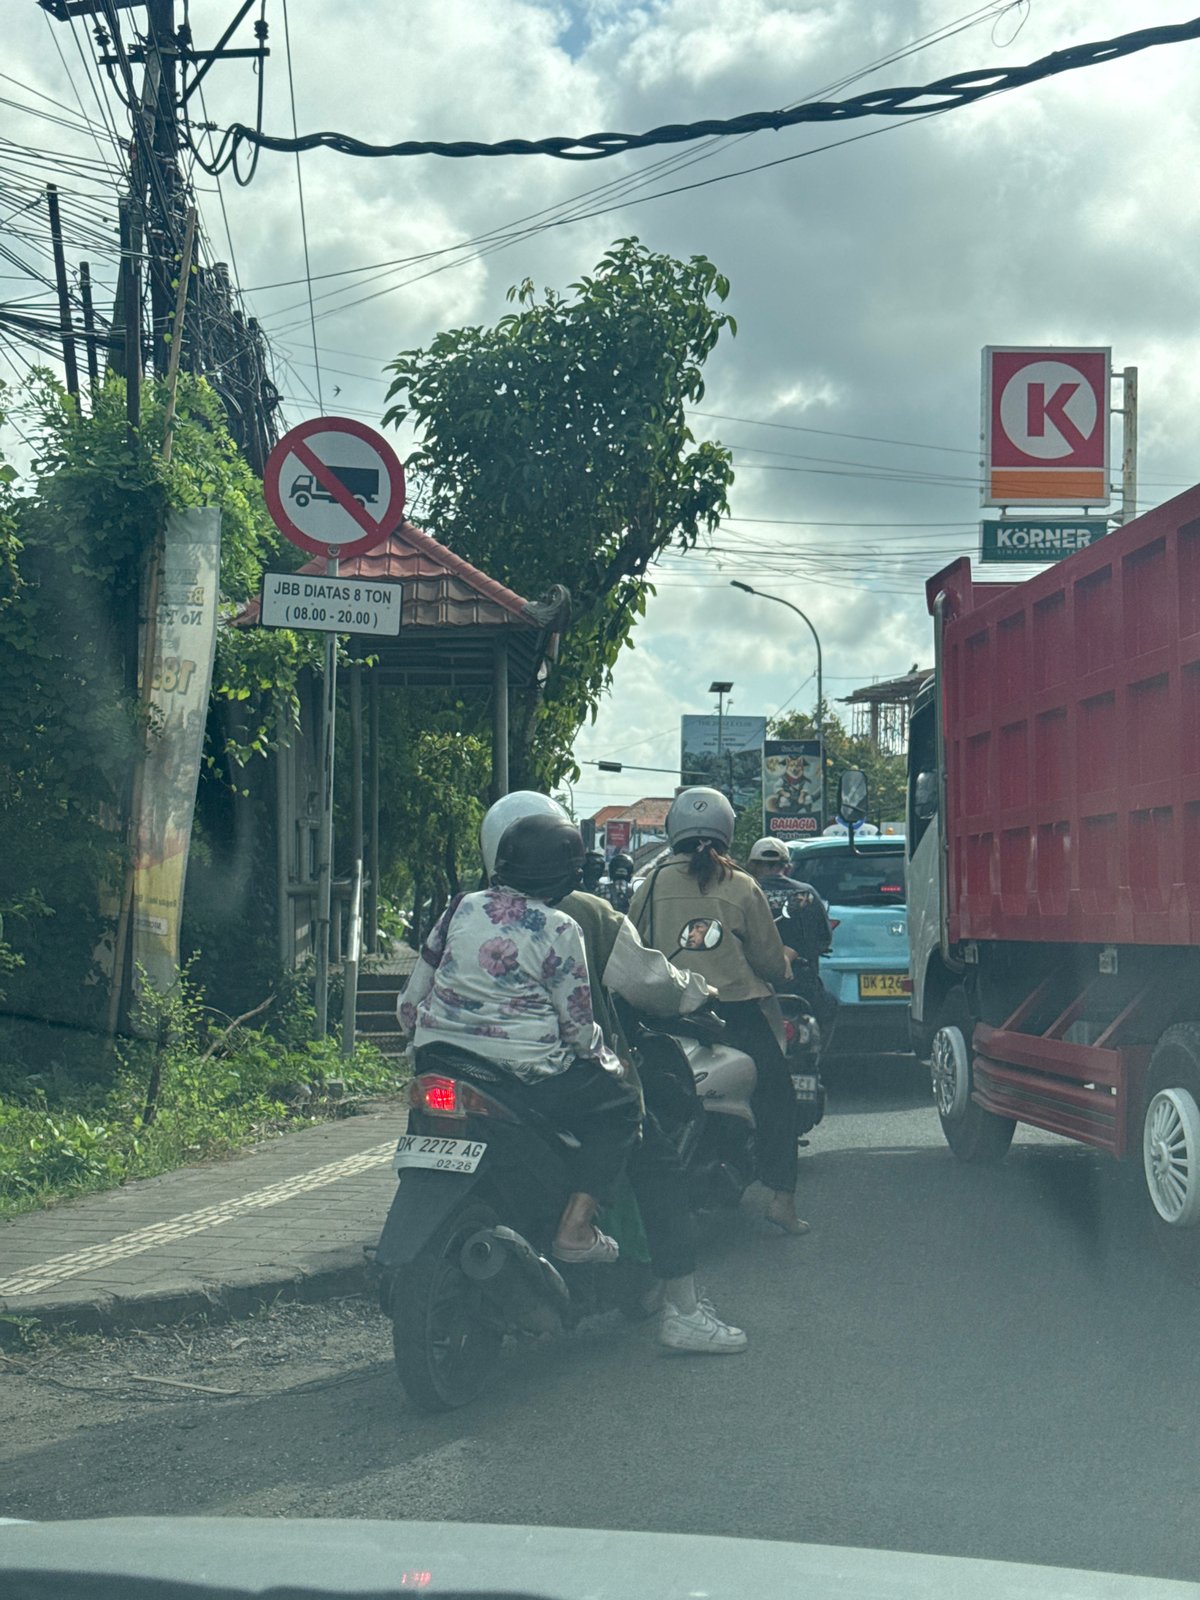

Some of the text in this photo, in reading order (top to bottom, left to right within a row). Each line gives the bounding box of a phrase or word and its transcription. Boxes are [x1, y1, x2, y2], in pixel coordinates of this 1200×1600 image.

[1027, 383, 1087, 453] K
[997, 527, 1092, 549] KÖRNER
[274, 581, 392, 604] JBB DIATAS 8 TON
[293, 606, 326, 622] 08.00
[337, 610, 371, 625] 20.00
[770, 817, 817, 830] BAHAGIA
[863, 975, 877, 989] DK
[397, 1136, 483, 1158] DK 2272 AG
